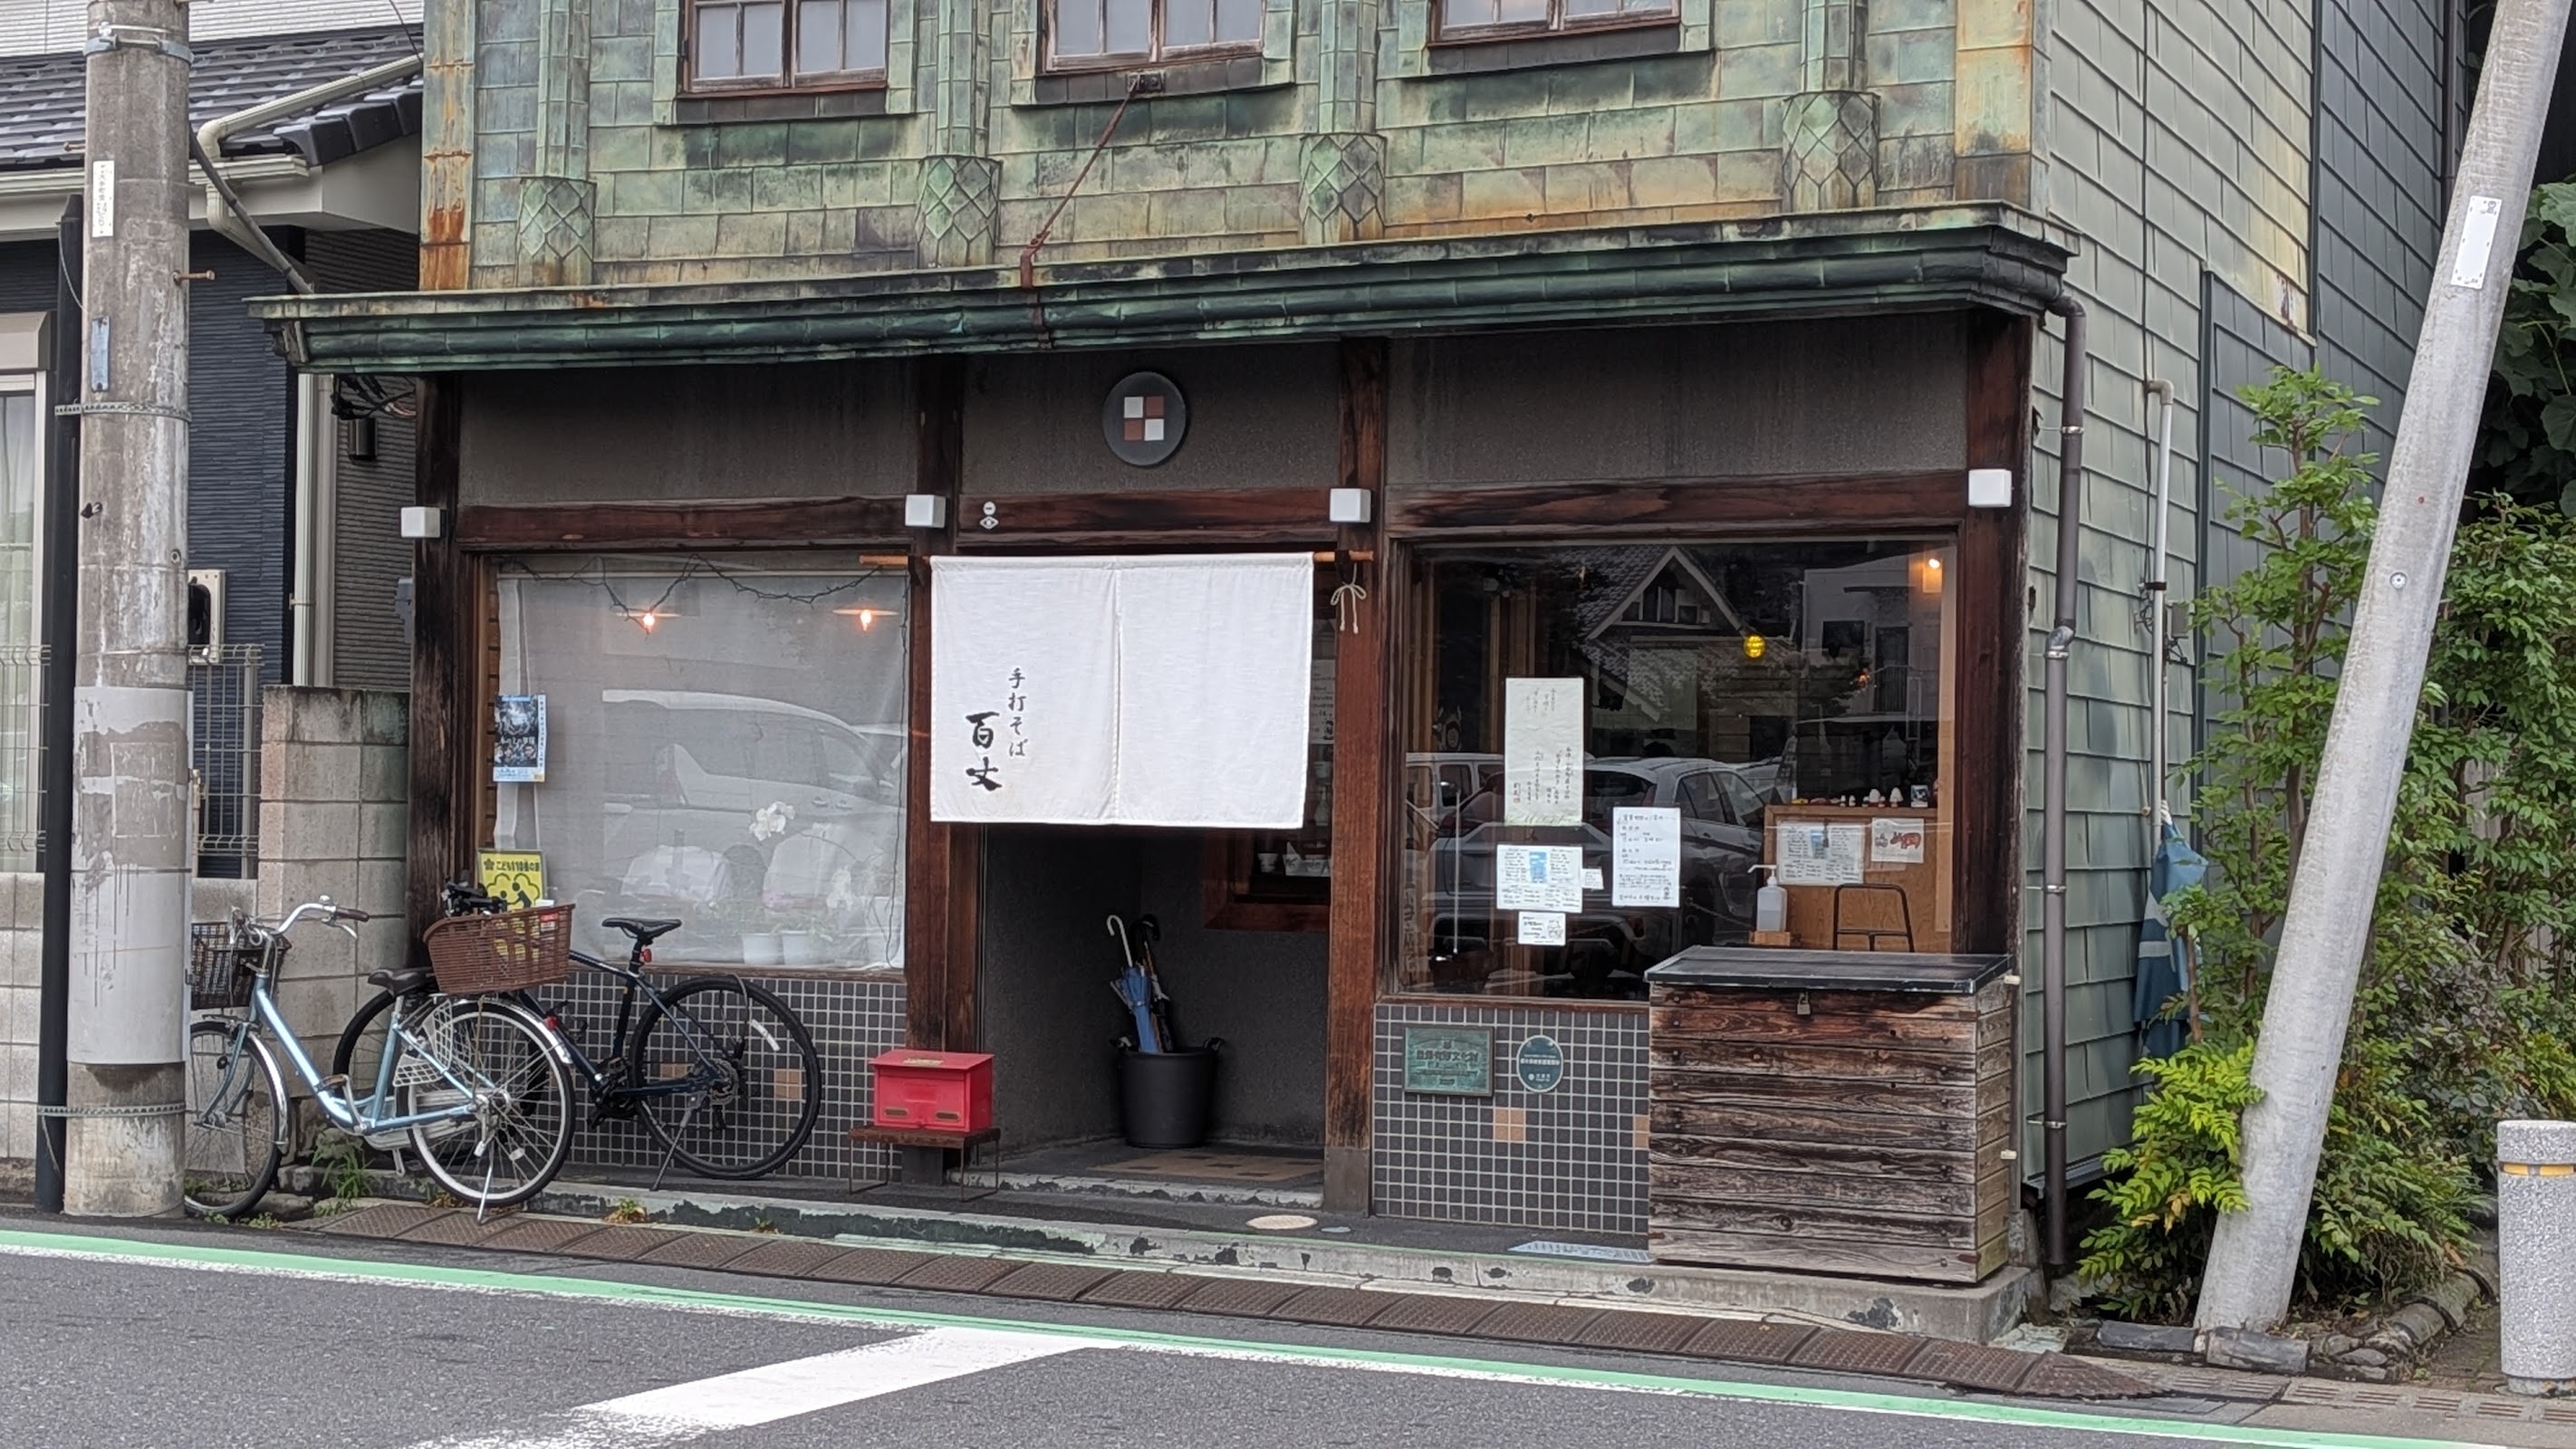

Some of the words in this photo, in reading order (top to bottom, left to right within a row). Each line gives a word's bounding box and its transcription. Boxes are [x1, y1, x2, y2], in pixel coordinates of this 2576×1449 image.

[966, 711, 1003, 792] 百丈
[1008, 667, 1028, 757] 手打そば
